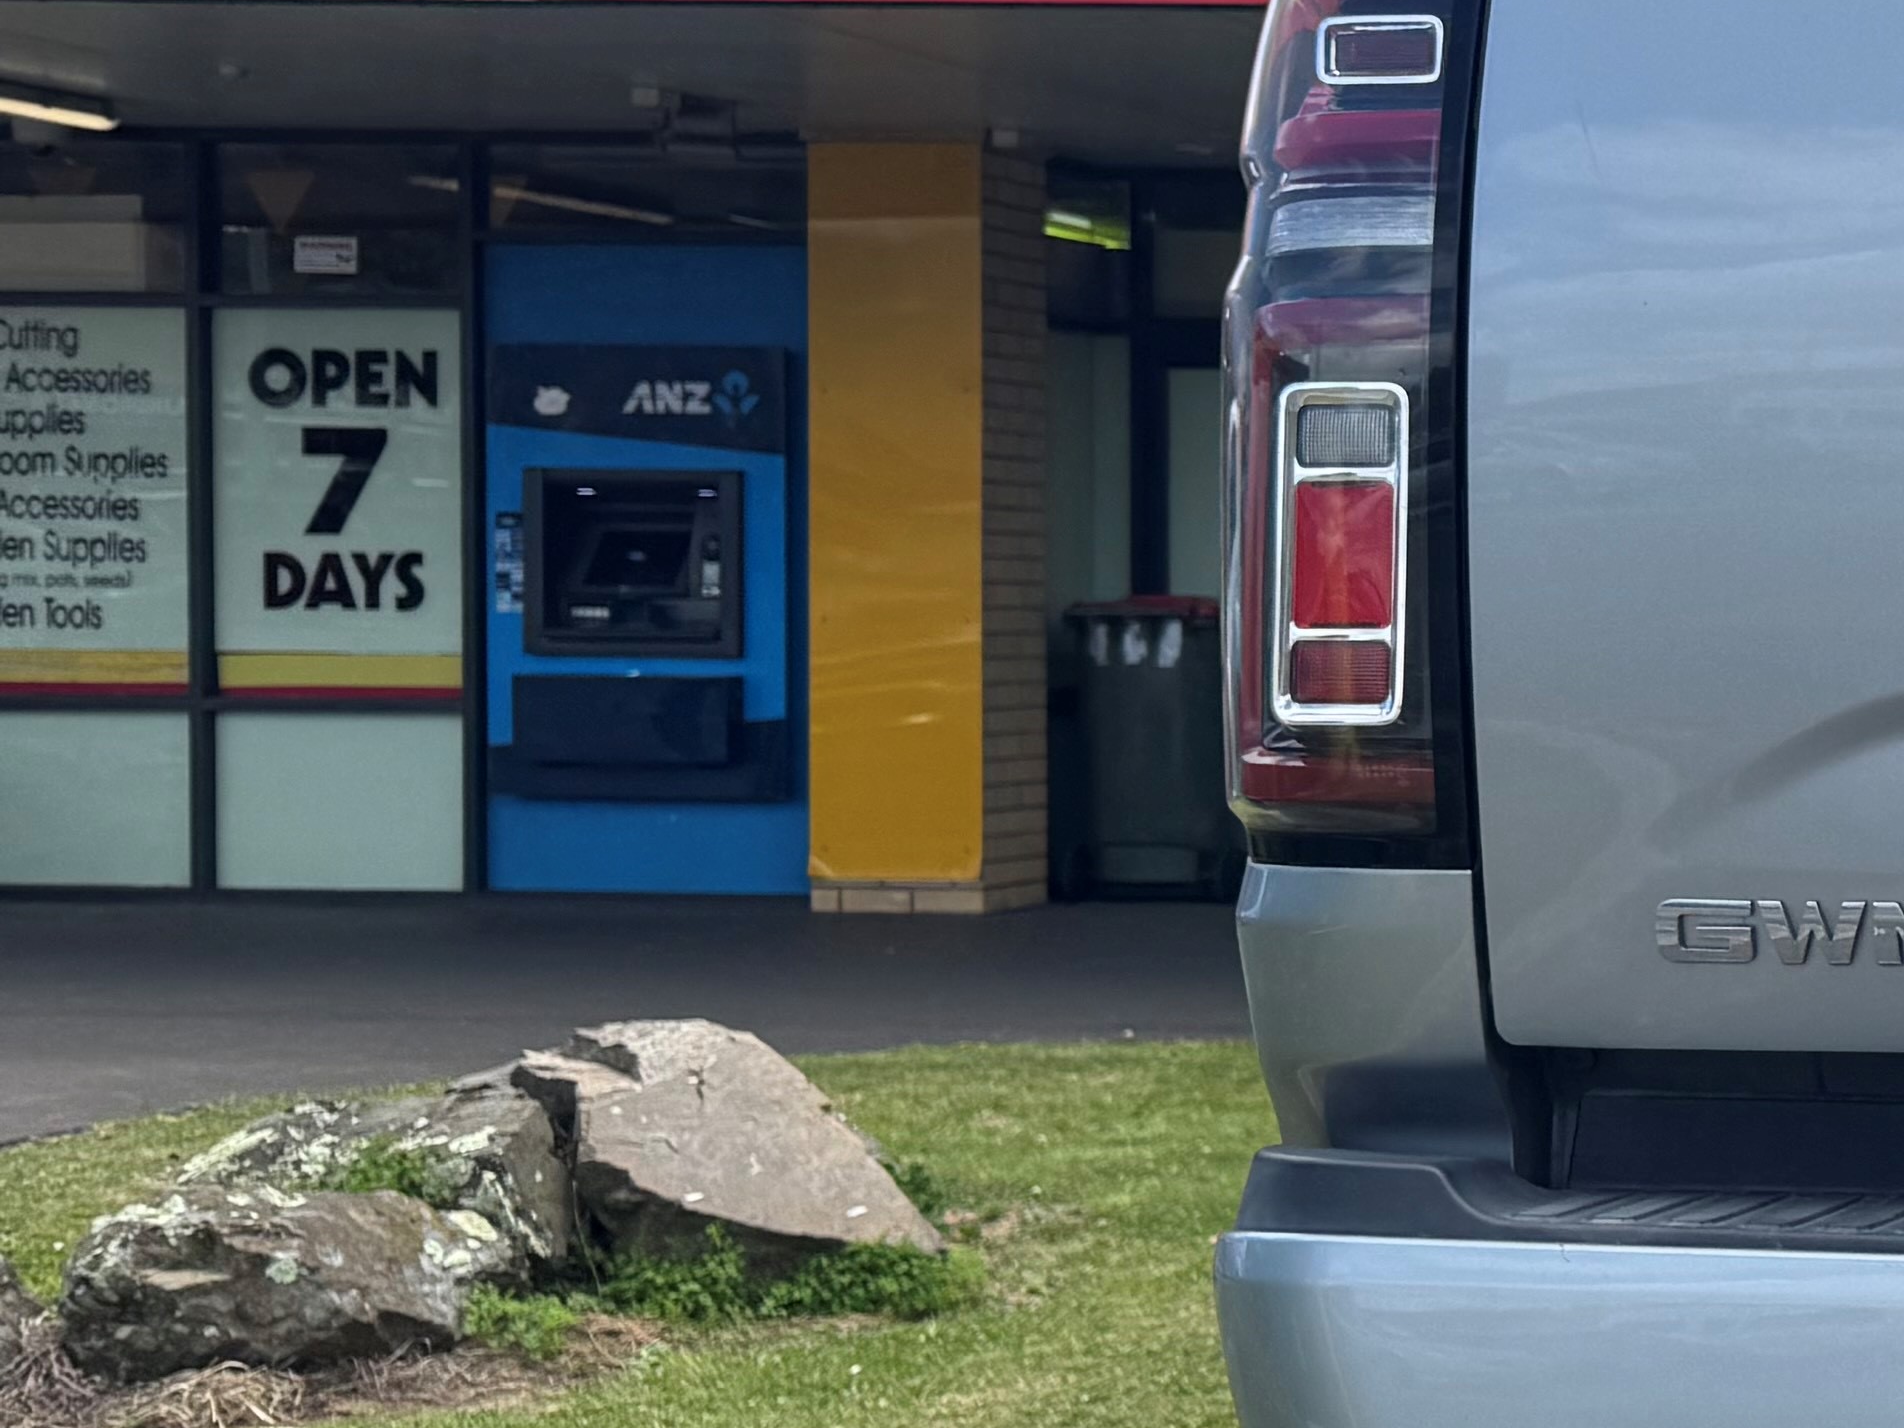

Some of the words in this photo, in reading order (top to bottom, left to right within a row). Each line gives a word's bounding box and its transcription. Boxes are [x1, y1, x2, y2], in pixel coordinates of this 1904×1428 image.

[4, 363, 152, 395] Accessories
[248, 347, 438, 408] OPEN
[622, 380, 713, 415] ANZ
[64, 445, 168, 482] Supplies
[302, 427, 388, 536] 7
[0, 529, 34, 561] en
[44, 530, 147, 568] Supplies
[262, 551, 425, 612] DAYS
[0, 598, 34, 628] en
[44, 597, 103, 629] Tools
